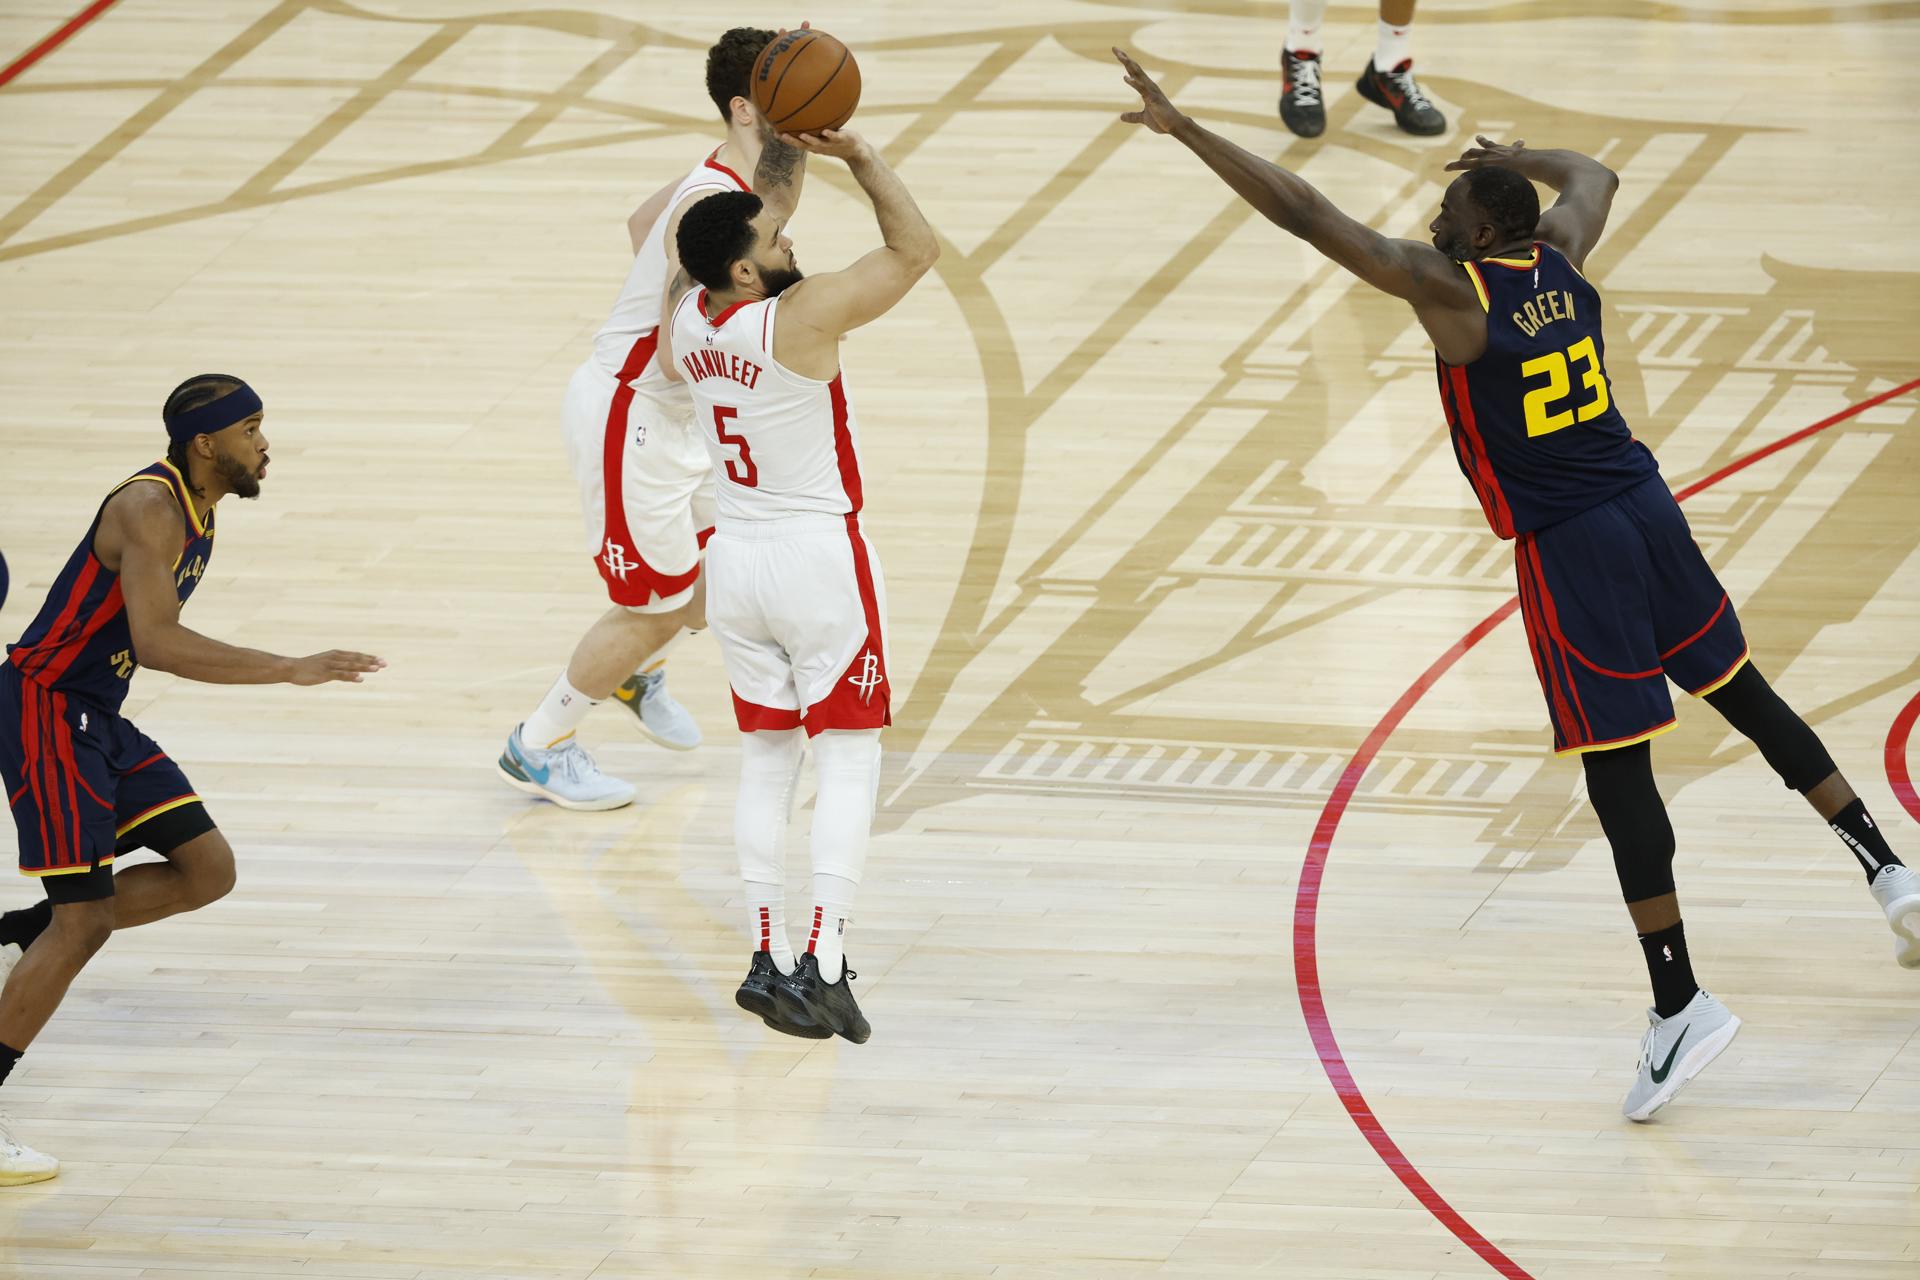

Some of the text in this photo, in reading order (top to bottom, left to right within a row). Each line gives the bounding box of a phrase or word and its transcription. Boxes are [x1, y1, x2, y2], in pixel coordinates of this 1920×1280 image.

[1512, 289, 1577, 338] GREEN
[682, 349, 763, 391] VANVLEET
[1521, 335, 1609, 438] 23
[712, 405, 759, 488] 5
